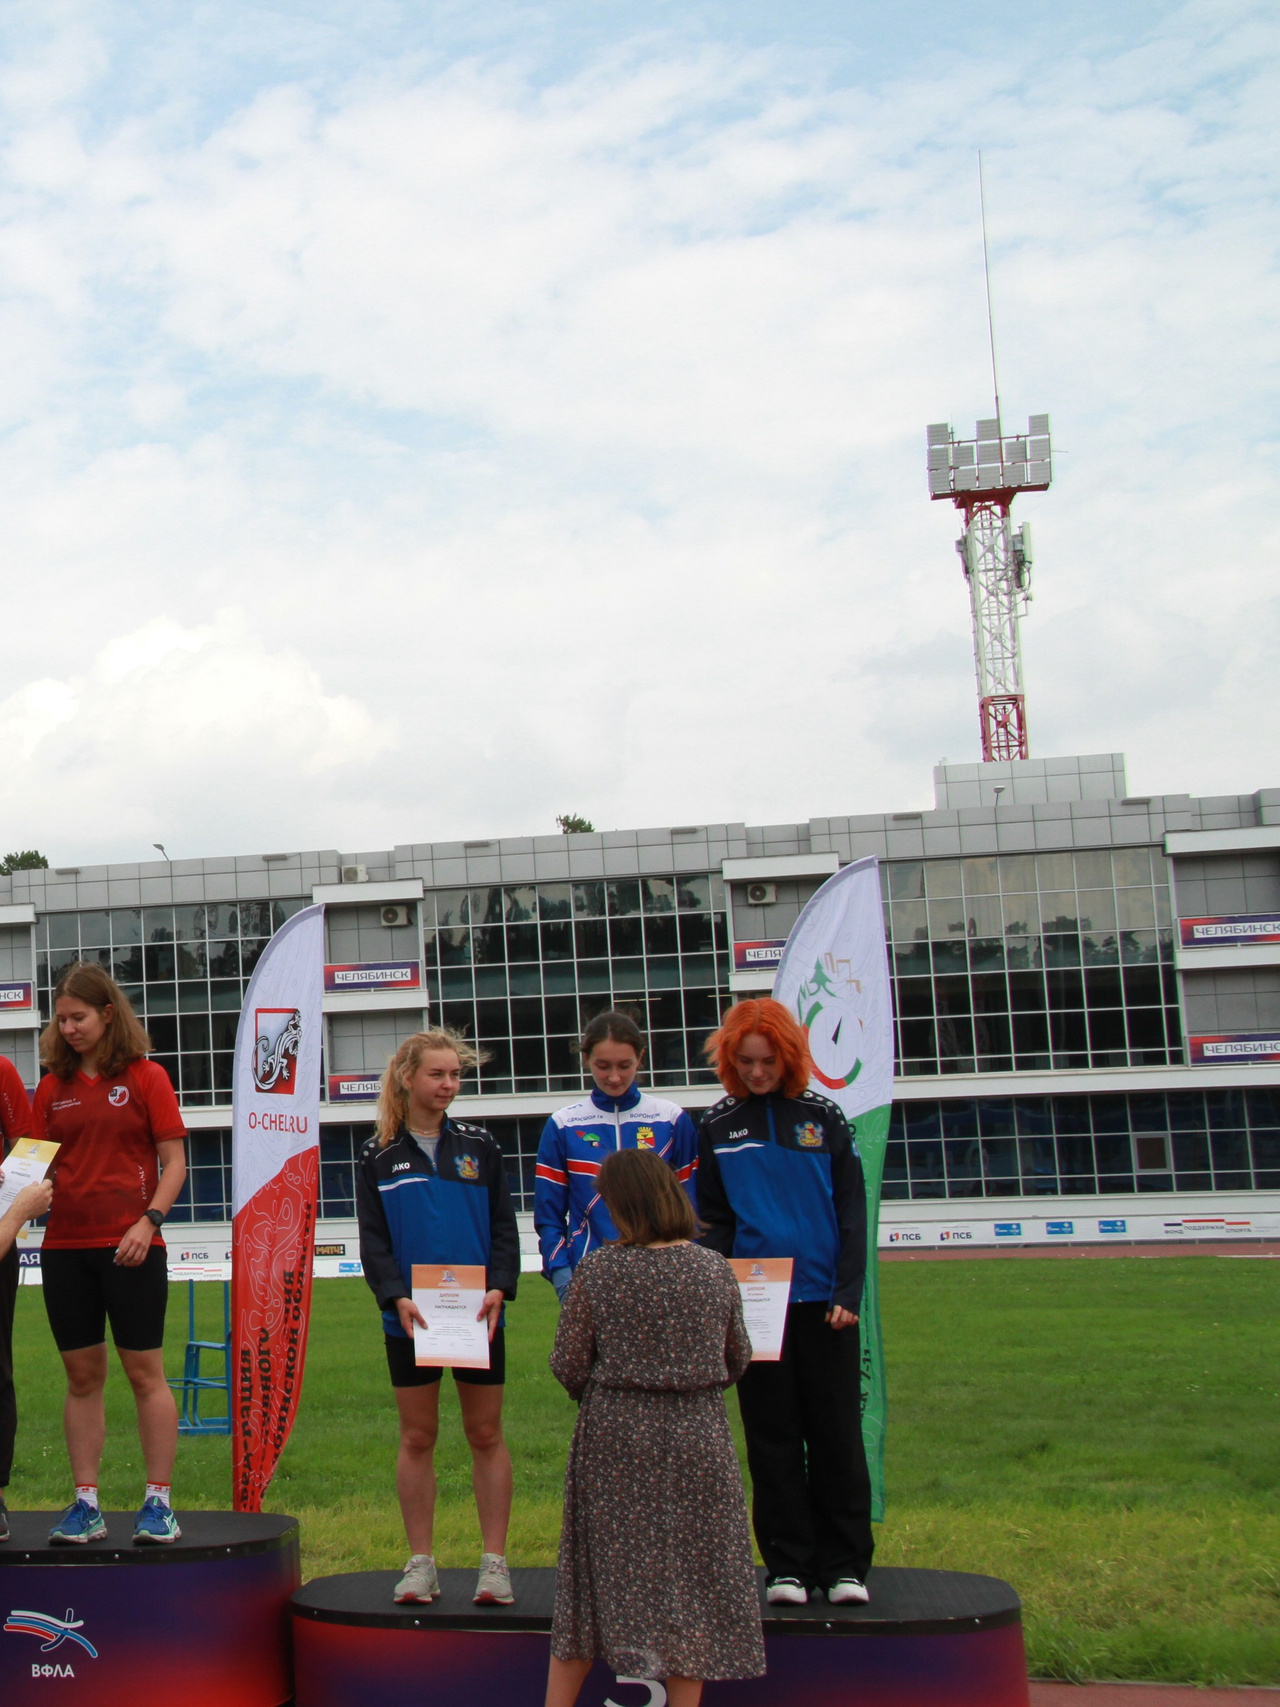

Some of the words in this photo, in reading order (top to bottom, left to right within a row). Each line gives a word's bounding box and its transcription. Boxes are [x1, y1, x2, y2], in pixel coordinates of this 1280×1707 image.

[336, 970, 409, 982] ЧЕЛЯБИНСК
[728, 1128, 748, 1139] JAKO
[391, 1162, 410, 1173] JAKO
[32, 1664, 75, 1677] ВФЛА
